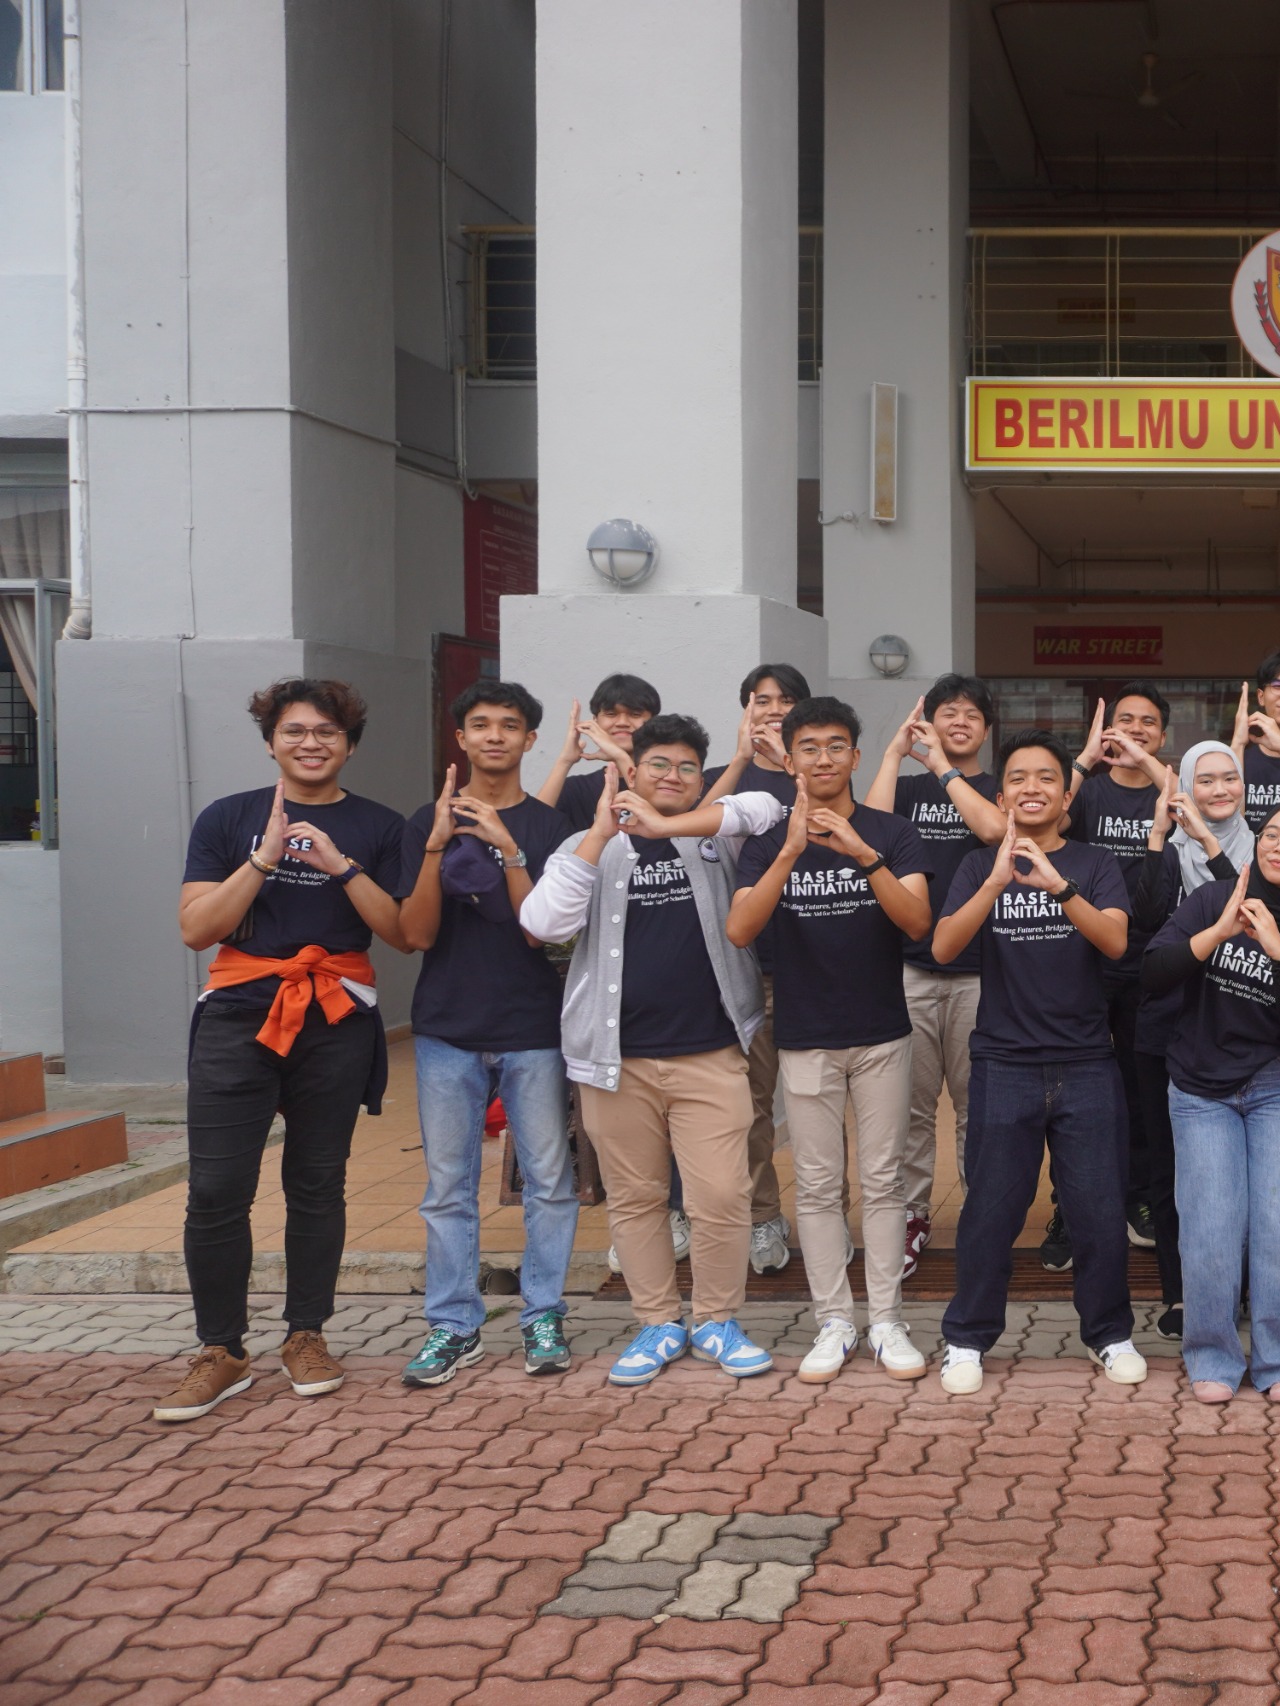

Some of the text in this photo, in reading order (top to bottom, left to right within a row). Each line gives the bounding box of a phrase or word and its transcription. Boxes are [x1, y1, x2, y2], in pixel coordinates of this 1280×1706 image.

[995, 398, 1209, 450] BERILMU
[1036, 638, 1160, 655] WAR STREET
[921, 802, 954, 814] BASE
[1105, 816, 1140, 830] BASE
[791, 870, 834, 884] BASE
[791, 878, 868, 897] INITIATIVE
[1003, 891, 1048, 905] BASE
[1222, 942, 1267, 968] BASE
